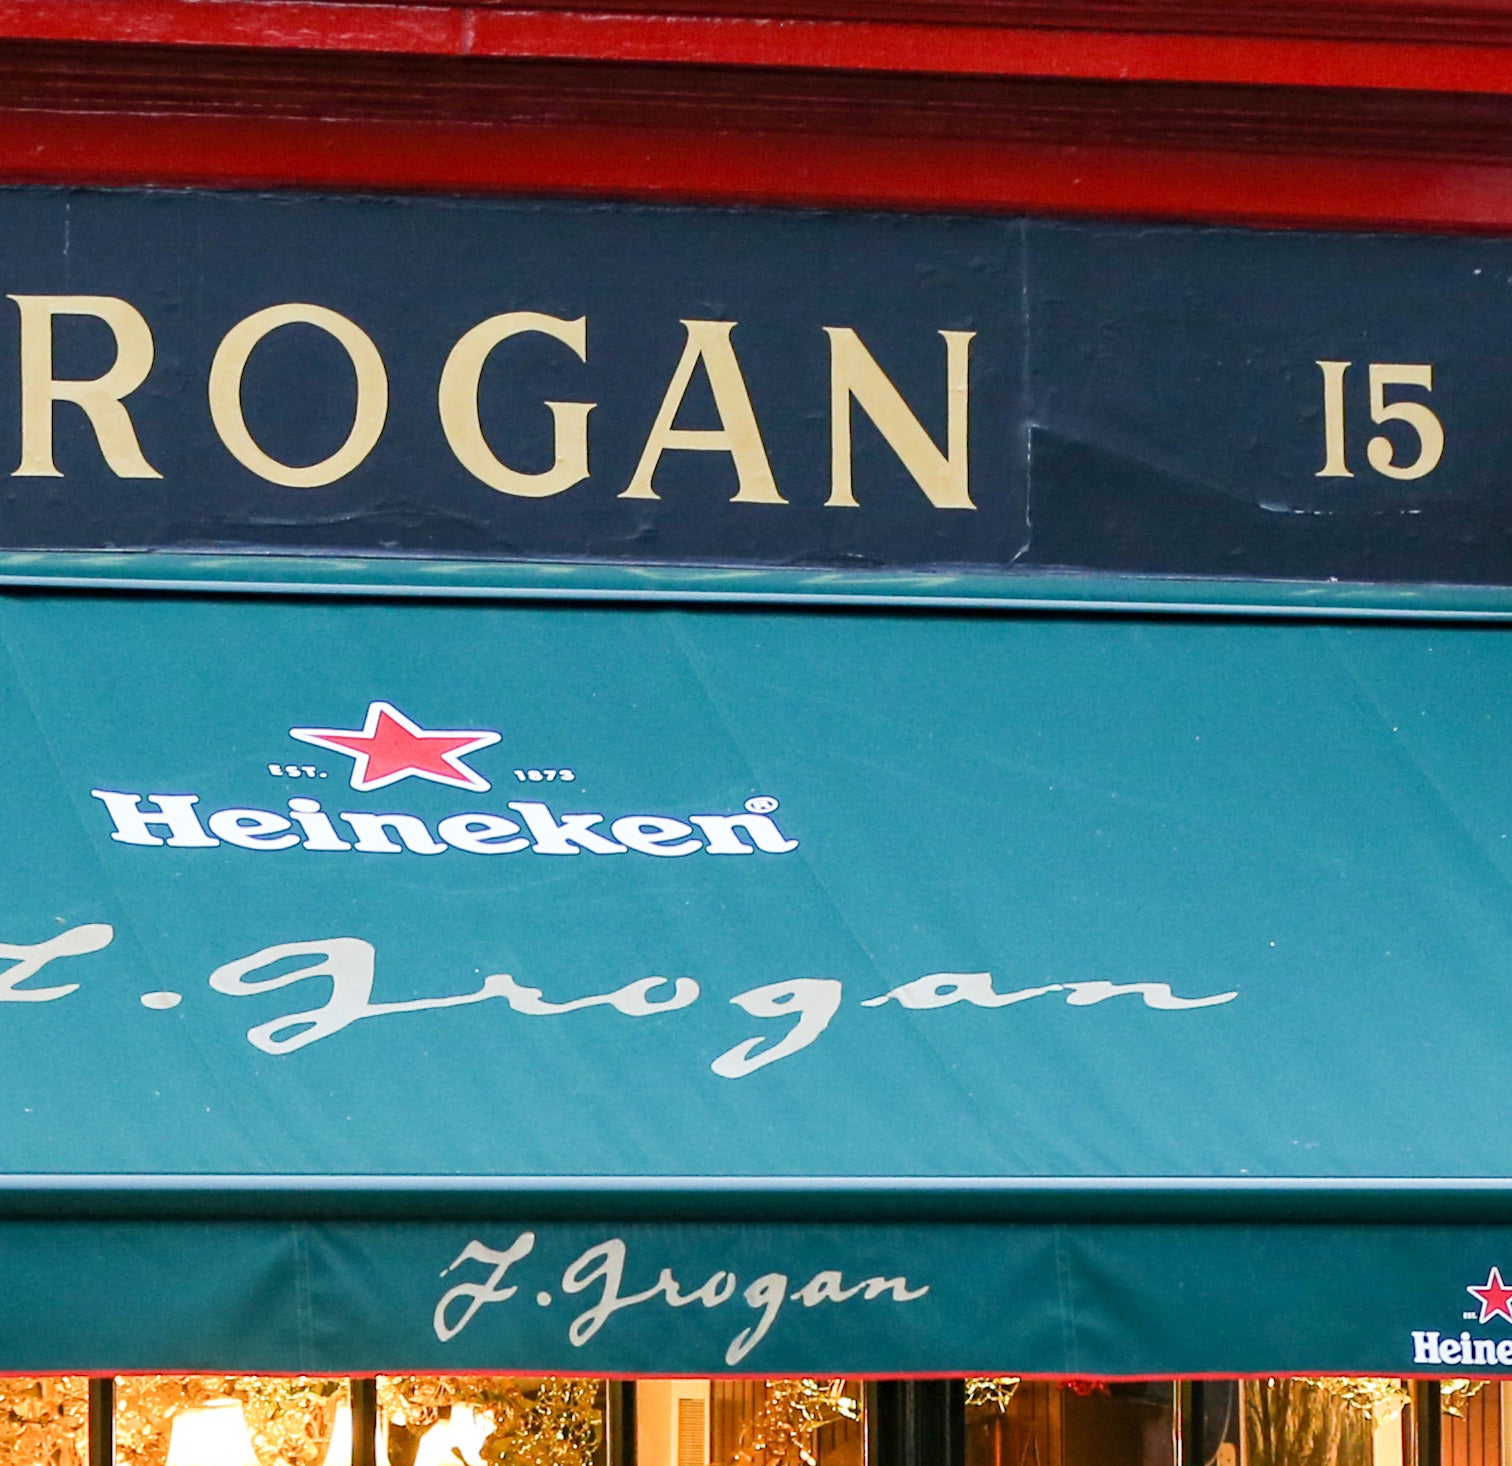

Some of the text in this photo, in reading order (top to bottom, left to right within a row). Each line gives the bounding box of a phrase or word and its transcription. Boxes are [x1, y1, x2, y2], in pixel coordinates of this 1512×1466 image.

[1314, 360, 1445, 482] 15
[268, 764, 577, 783] EST. 1873
